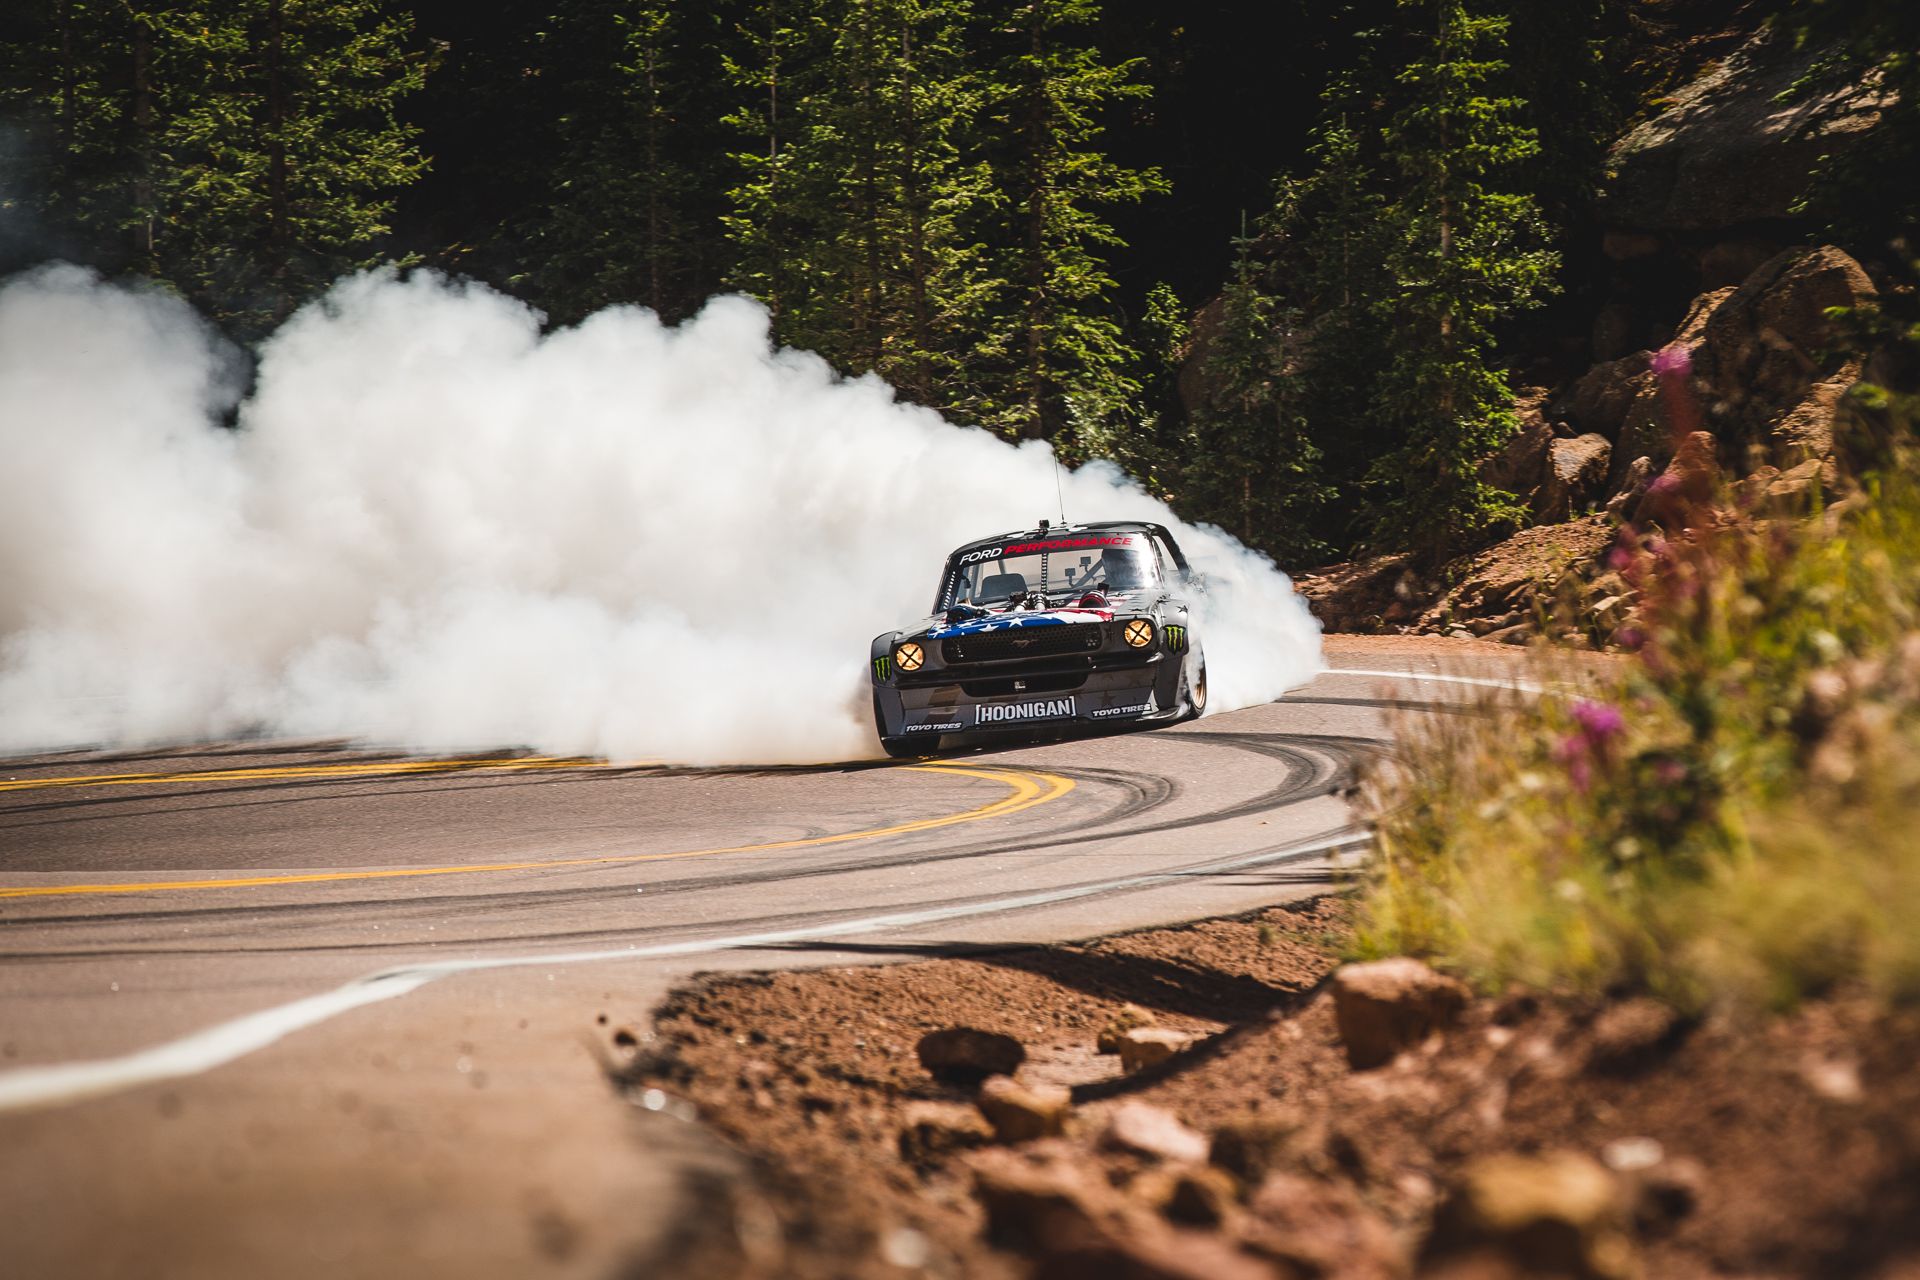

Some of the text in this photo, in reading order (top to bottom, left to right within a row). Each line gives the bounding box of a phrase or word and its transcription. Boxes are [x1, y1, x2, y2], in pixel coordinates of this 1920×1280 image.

[959, 537, 1134, 566] FORD PERFORMANCE
[1092, 703, 1151, 717] TOYO TIRES
[906, 722, 962, 732] TOYO TIRES
